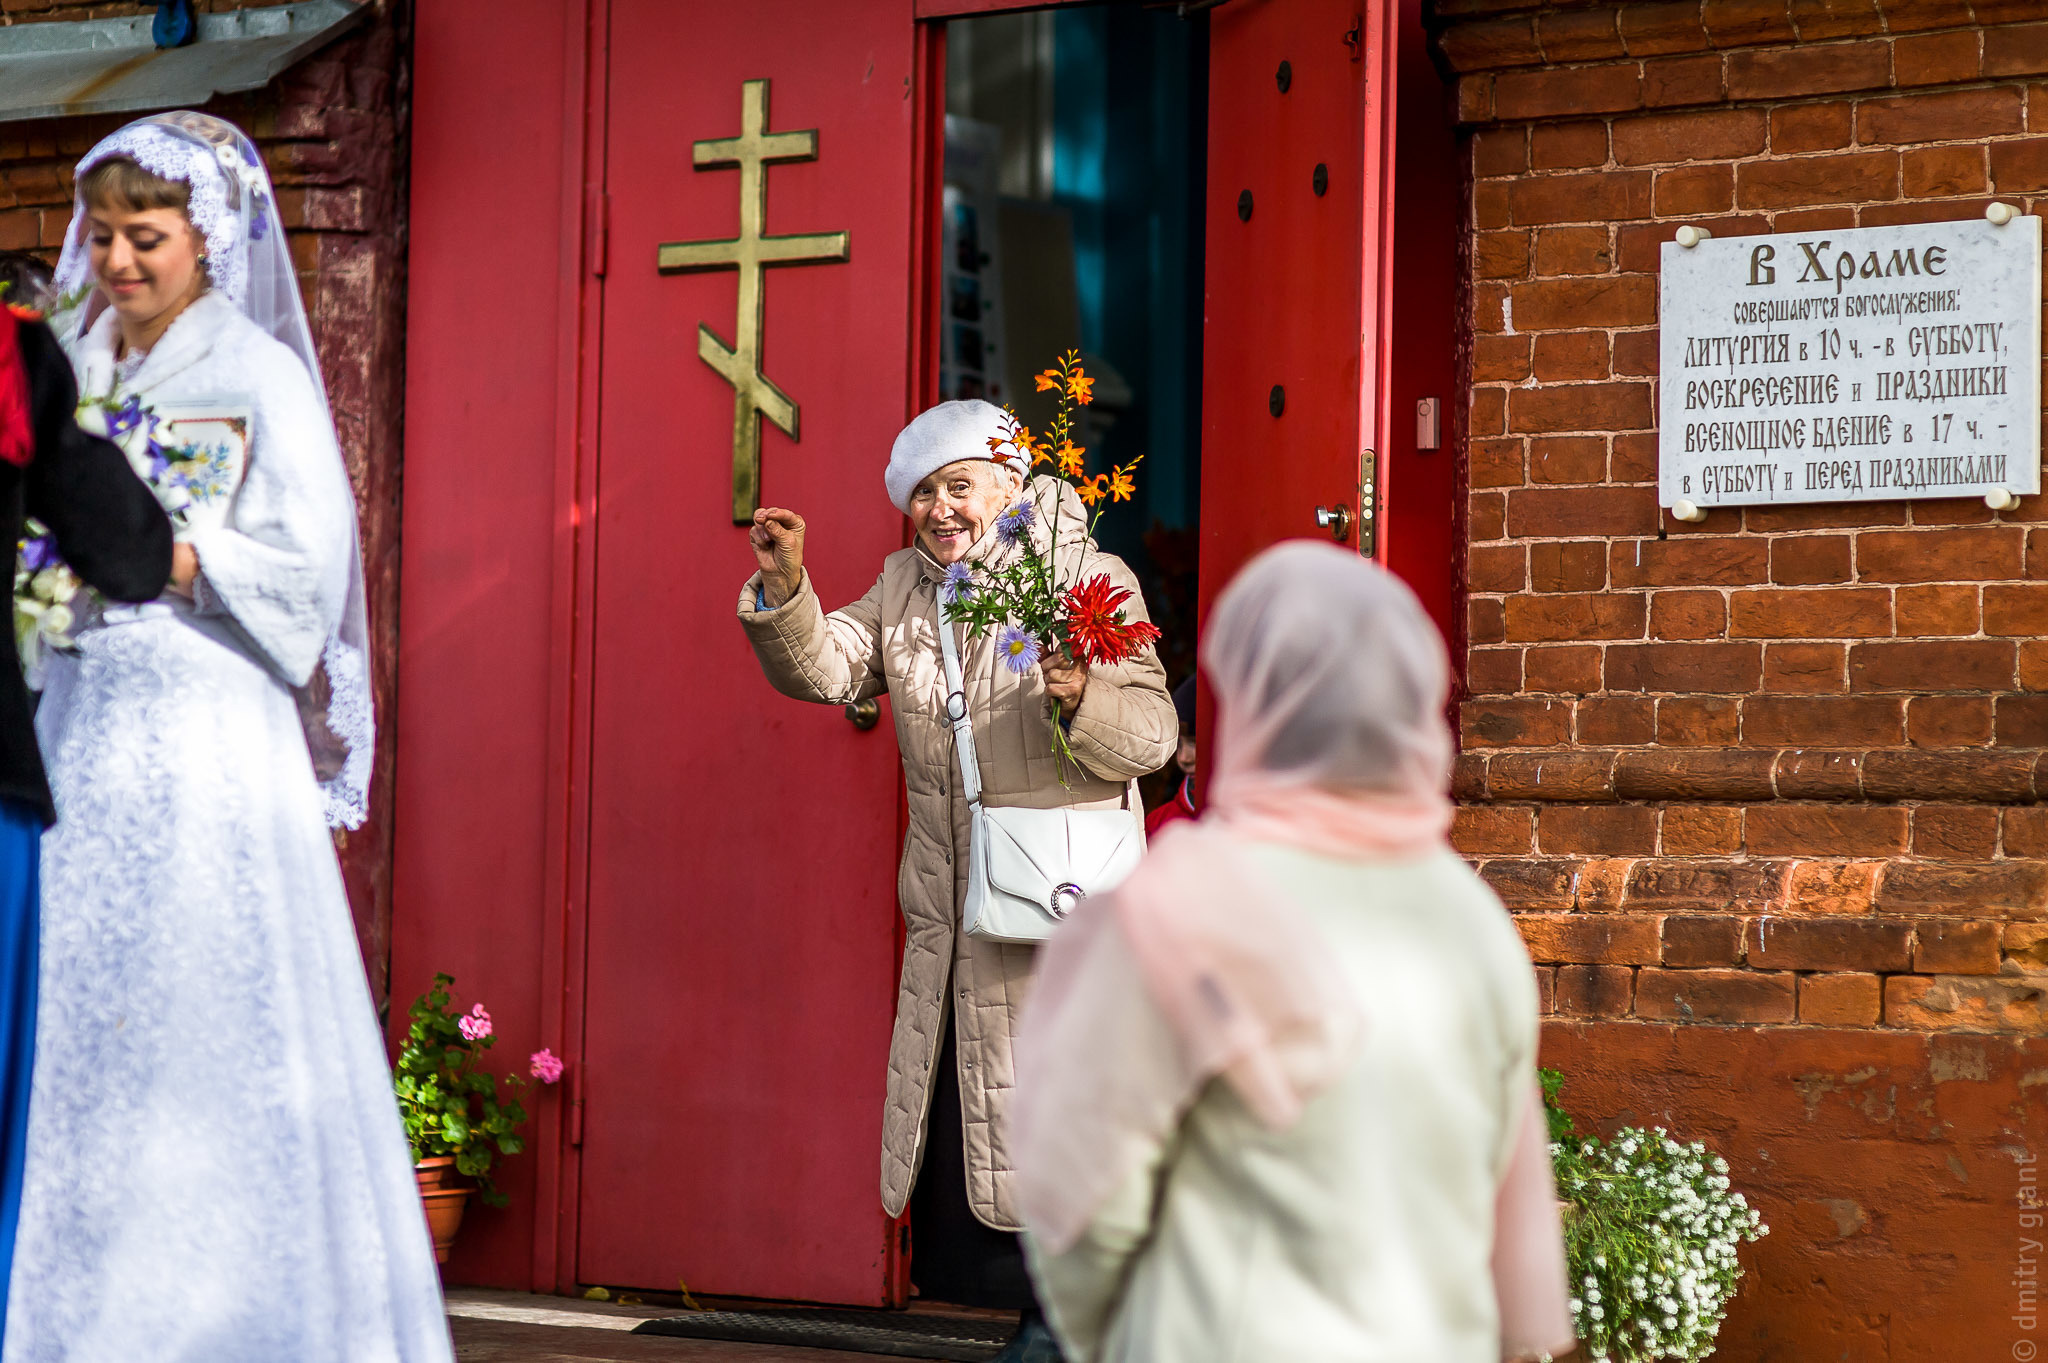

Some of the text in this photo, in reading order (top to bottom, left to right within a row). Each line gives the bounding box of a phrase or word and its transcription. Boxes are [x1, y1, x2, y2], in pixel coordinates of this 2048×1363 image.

[1746, 244, 1776, 286] В
[1685, 334, 1790, 374] ЛИТУРГИЯ
[1820, 329, 1841, 360] 10
[1850, 341, 1862, 359] ч.
[1909, 323, 2008, 365] СУББОТУ,
[1685, 374, 1840, 410] ВОСКРЕСЕНИЕ
[1877, 366, 2007, 403] ПРАЗДНИКИ
[1685, 418, 1806, 456] ВСЕНОЩНОЕ
[1812, 415, 1892, 448] БДЕНИЕ
[1932, 414, 1954, 444] 17
[1968, 420, 1983, 440] ч.
[1703, 464, 1777, 501] СУББОТУ
[1805, 460, 1862, 492] ПЕРЕД
[1869, 455, 2007, 492] ПРАЗДНИКАМИ
